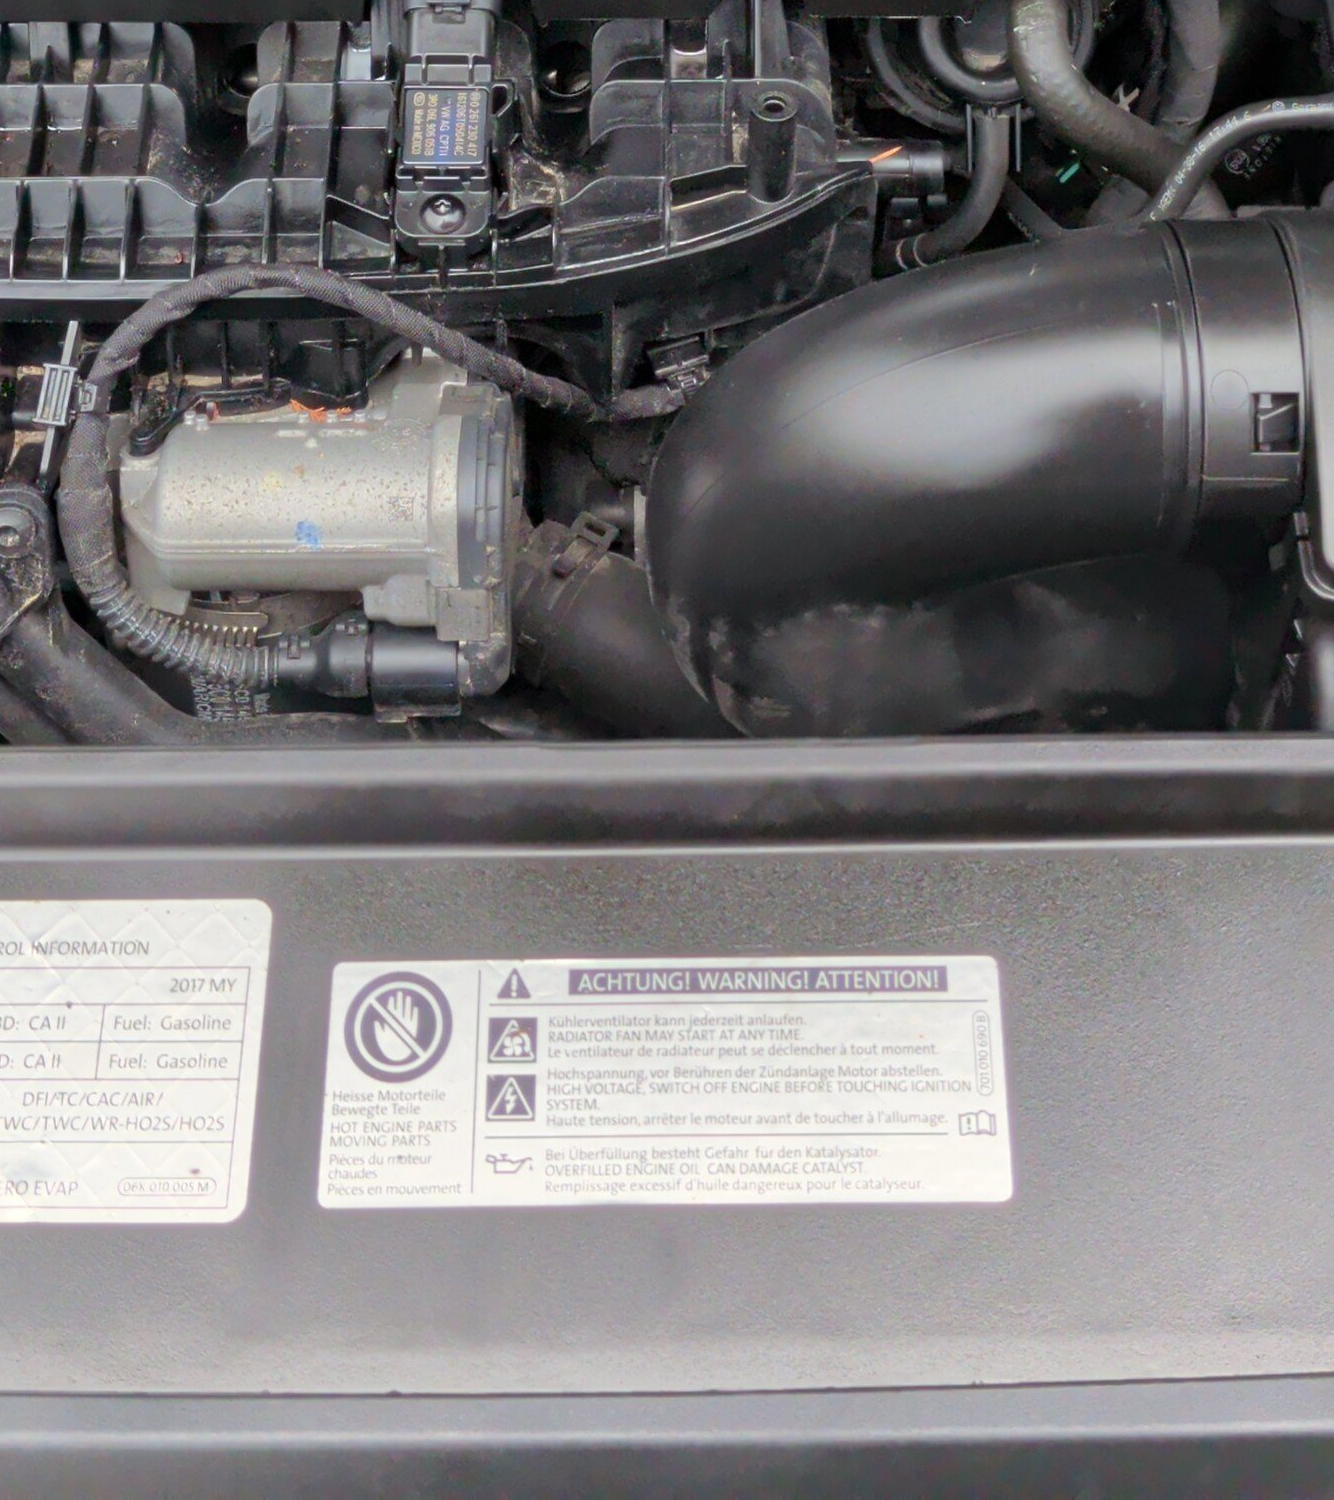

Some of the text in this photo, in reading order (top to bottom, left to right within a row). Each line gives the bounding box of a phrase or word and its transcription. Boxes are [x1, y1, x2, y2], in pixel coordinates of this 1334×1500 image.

[32, 941, 150, 956] INFORMATION
[169, 978, 238, 993] 2017 MY
[577, 969, 940, 992] ACHTUNG! WARNING! ATTENTION!
[29, 1015, 52, 1031] CA
[56, 1016, 67, 1031] II
[113, 1015, 233, 1031] Fuel: Gasoline
[654, 1014, 686, 1027] kann
[688, 1013, 743, 1030] jederzeit
[747, 1013, 807, 1026] anlaufen.
[548, 1029, 804, 1043] RADIATOR FAN MAY START AT ANY TIME.
[547, 1044, 939, 1060] Le ventilateur de radiateur peut se tout moment.
[23, 1054, 47, 1069] CA
[109, 1053, 229, 1069] Fuel: Gasoline
[650, 1070, 670, 1079] vor
[735, 1066, 756, 1078] der
[838, 1065, 878, 1077] Motor
[881, 1065, 943, 1077] abstellen.
[332, 1089, 447, 1102] Heisse Motorteile
[547, 1080, 972, 1096] HIGH VOLTAGE, SWITCH OFF ENGINE BEFORE TOUCHING IGNITION
[332, 1103, 421, 1119] Bewegte Teile
[546, 1099, 600, 1111] SYSTEM.
[330, 1120, 457, 1134] HOT ENGINE PARTS
[546, 1115, 586, 1127] Haute
[589, 1115, 641, 1128] tension,
[690, 1113, 701, 1125] le
[704, 1114, 752, 1125] moteur
[755, 1113, 792, 1125] avant
[796, 1112, 811, 1124] de
[814, 1112, 863, 1124] toucher
[329, 1135, 431, 1148] MOVING PARTS
[368, 1153, 384, 1166] du
[545, 1148, 565, 1161] Bei
[651, 1147, 700, 1159] besteht
[705, 1146, 748, 1159] Gefahr
[777, 1146, 801, 1158] den
[328, 1168, 378, 1180] chaudes
[545, 1164, 622, 1176] OVERFILLED
[625, 1163, 675, 1176] ENGINE
[679, 1162, 700, 1175] OIL
[707, 1162, 735, 1175] CAN
[739, 1162, 798, 1174] DAMAGE
[34, 1180, 79, 1195] EVAP
[368, 1186, 382, 1195] en
[386, 1183, 462, 1195] mouvement
[545, 1180, 626, 1195] Remplissage
[630, 1179, 680, 1191] excessif
[732, 1179, 802, 1194] dangereux
[806, 1180, 836, 1193] pour
[841, 1178, 851, 1190] le
